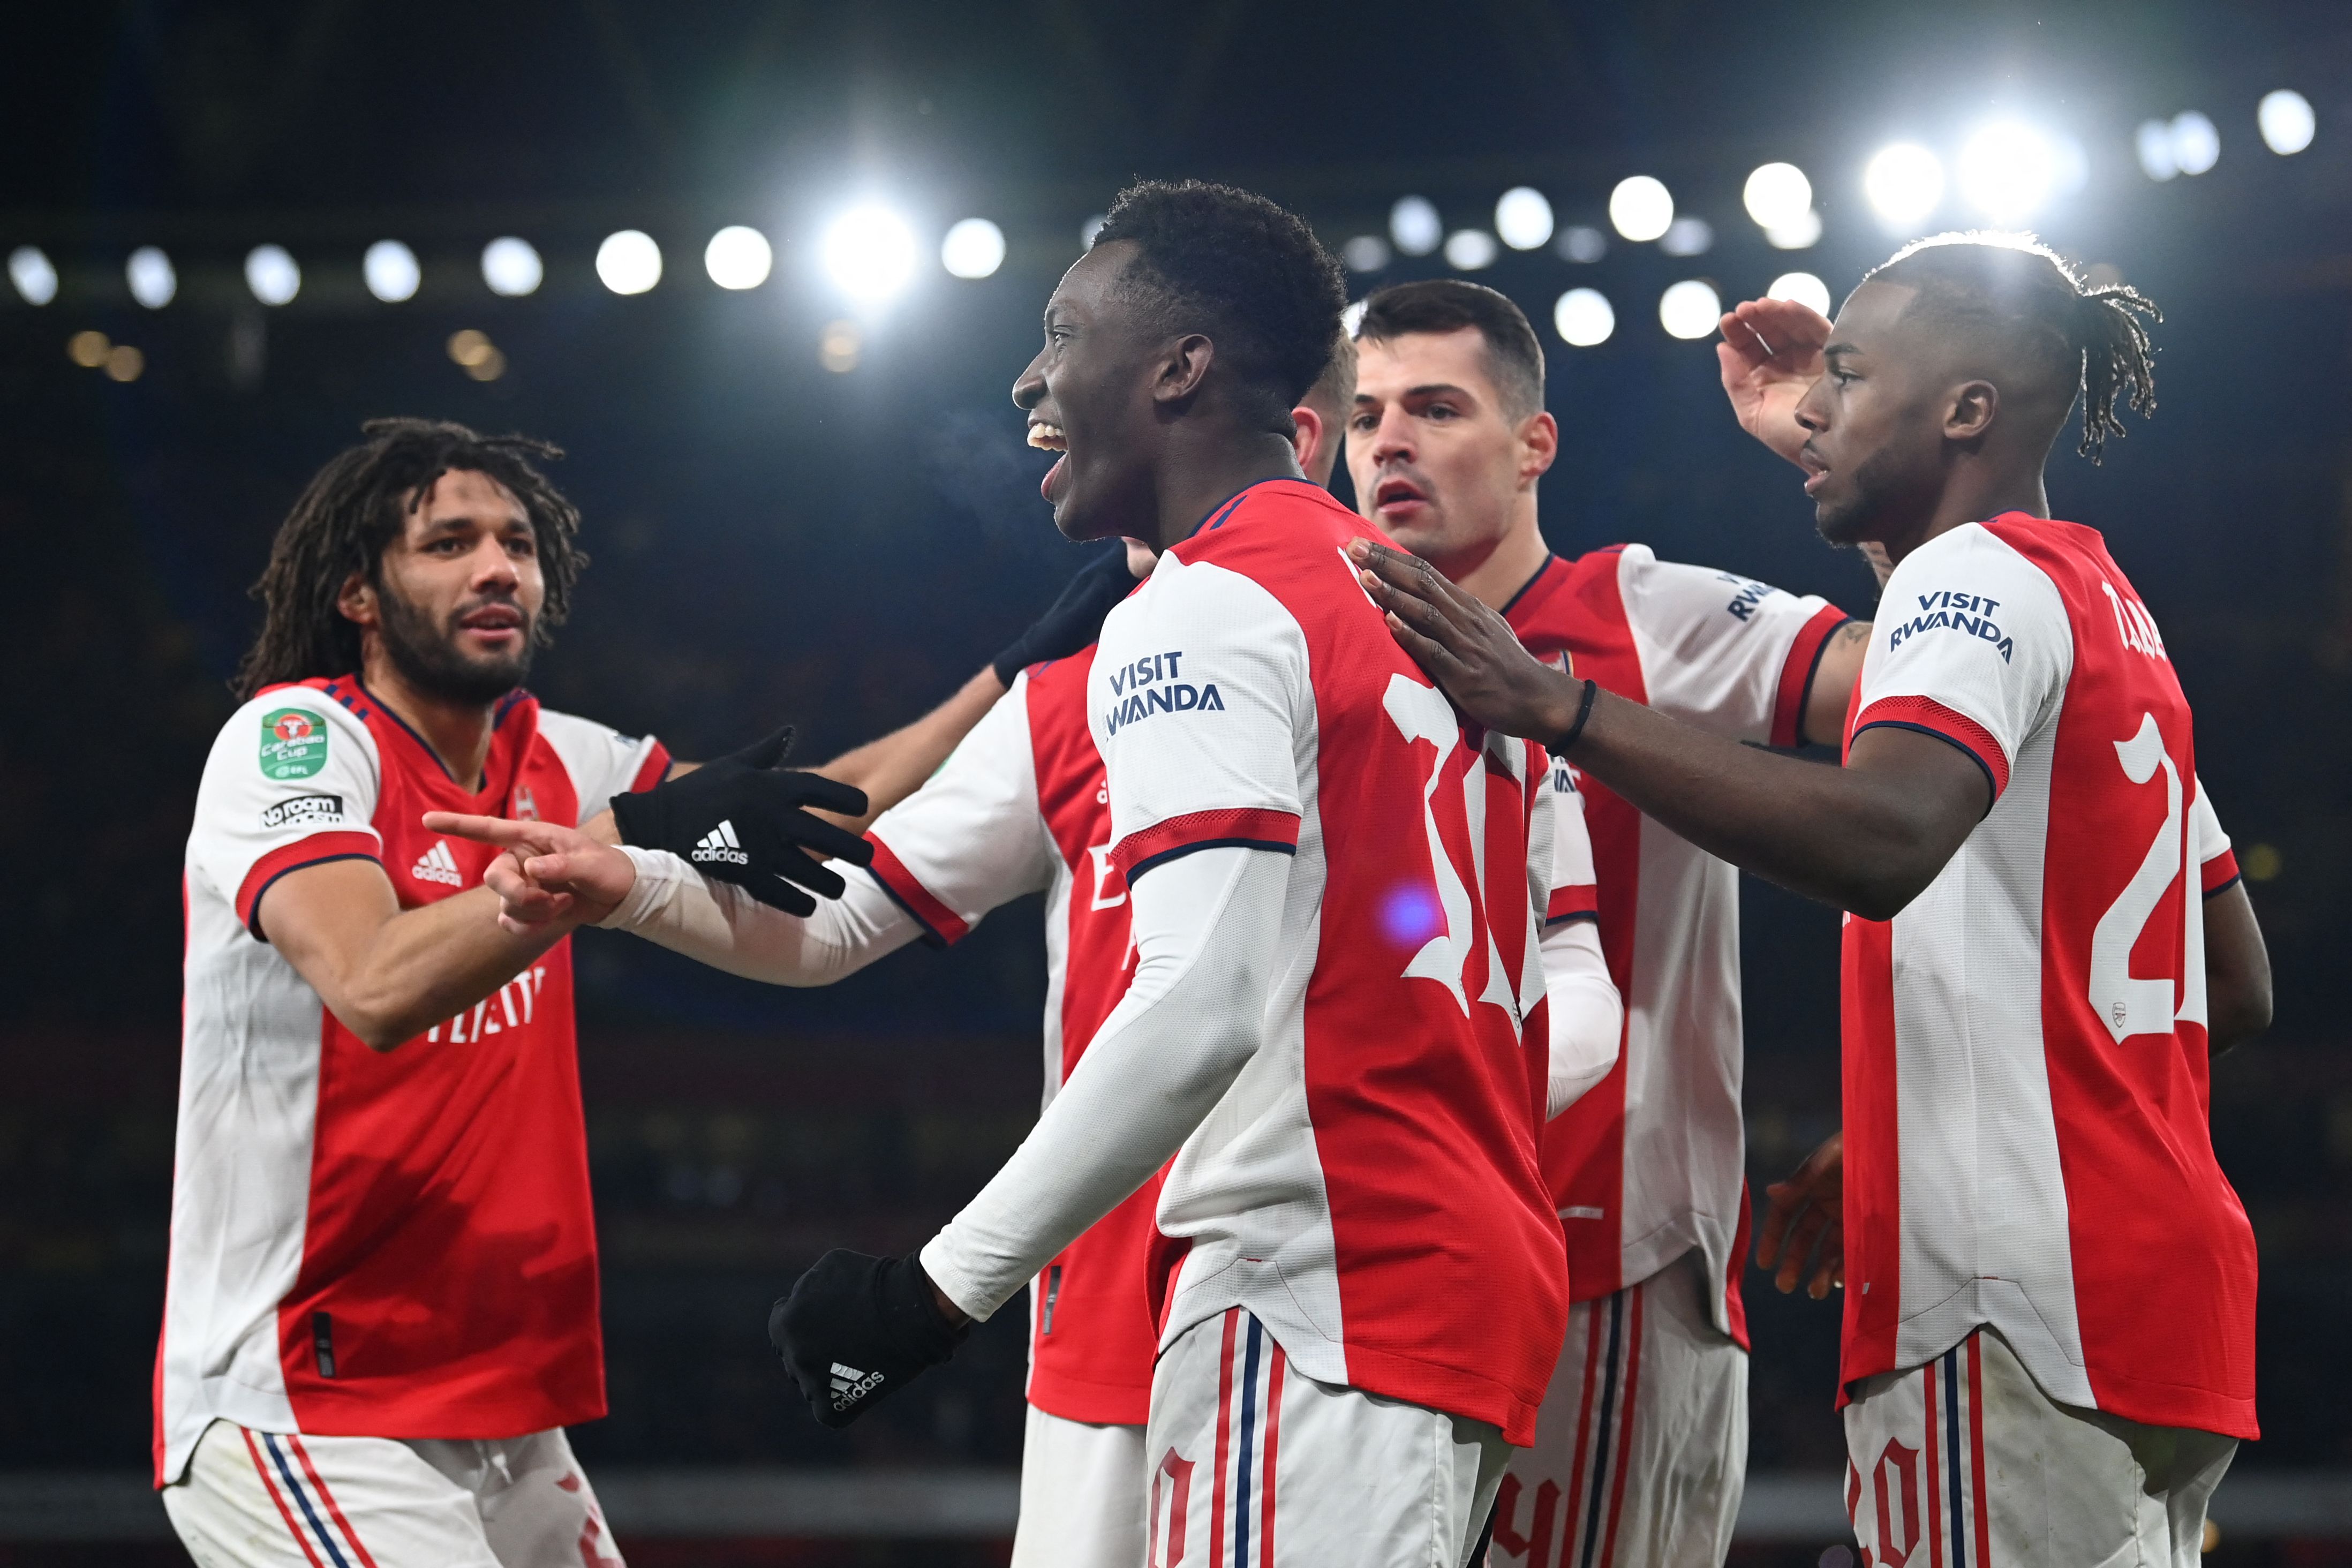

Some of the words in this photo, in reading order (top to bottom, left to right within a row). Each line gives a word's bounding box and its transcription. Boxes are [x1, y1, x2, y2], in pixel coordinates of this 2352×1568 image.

[1918, 591, 2000, 617] VISIT
[1890, 611, 2013, 665] RWANDA
[1110, 651, 1182, 697] VISIT
[1105, 684, 1225, 743] WANDA
[261, 735, 326, 758] Carabao
[277, 747, 308, 761] Cup
[691, 846, 749, 865] adidas
[411, 864, 463, 888] adidas
[833, 1371, 885, 1411] adidas
